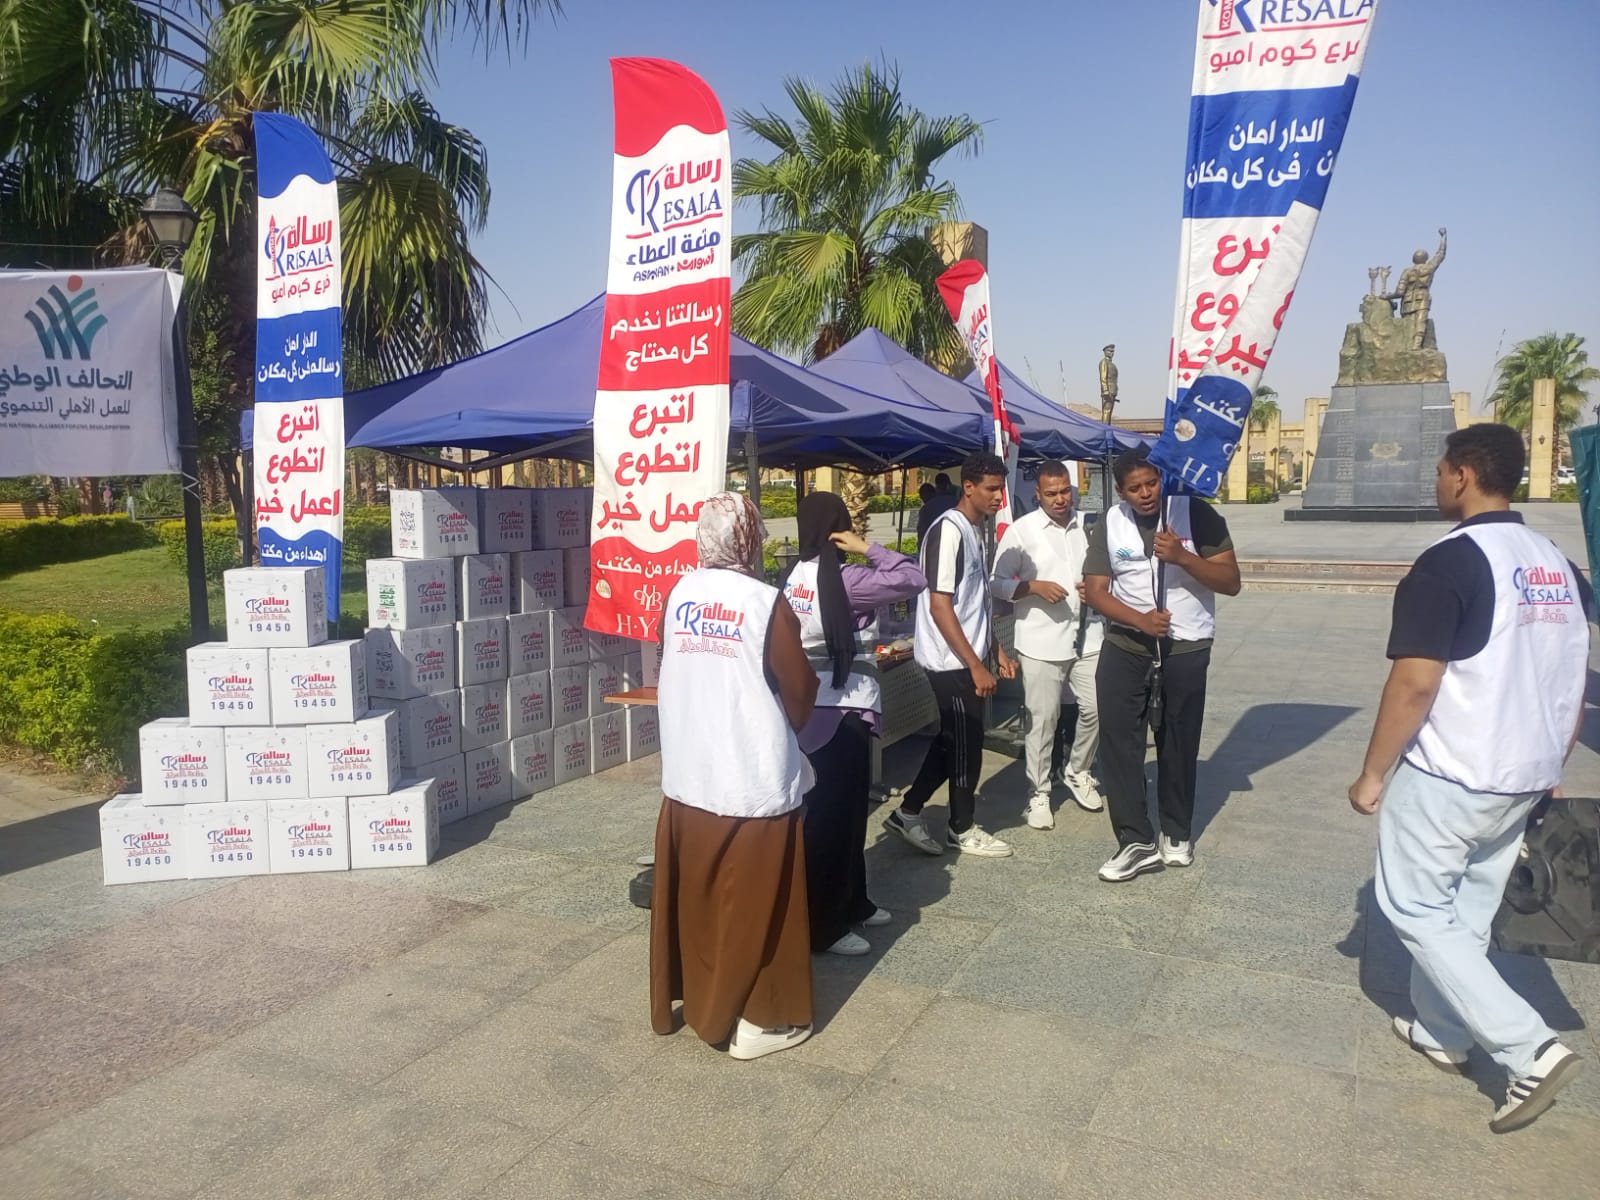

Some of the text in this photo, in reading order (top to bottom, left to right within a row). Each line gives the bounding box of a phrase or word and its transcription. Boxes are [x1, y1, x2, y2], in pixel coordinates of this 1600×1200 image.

[1210, 41, 1254, 73] امبو
[1258, 38, 1317, 67] كوم
[1228, 117, 1325, 152] الدار امان
[663, 158, 722, 190] رسالة
[1186, 159, 1229, 189] مكان
[1231, 156, 1265, 189] كل
[286, 215, 332, 249] رسالة
[626, 235, 677, 265] العطاء
[609, 301, 723, 340] رسالتنا نخدم
[625, 332, 709, 372] كل محتاج
[66, 367, 133, 391] التحالف
[258, 361, 287, 382] مكان
[59, 396, 95, 421] الأهلي
[99, 399, 131, 417] للعمل
[629, 391, 694, 439] اتبرع
[277, 404, 319, 443] اتبرع
[266, 446, 325, 485] اتطوع
[614, 440, 701, 487] اتطوع
[290, 488, 340, 523] اعمل
[597, 491, 705, 533] عمل خير
[596, 556, 642, 574] مكتب
[644, 560, 662, 579] من
[1529, 566, 1569, 588] رسالة
[676, 601, 743, 639] RESALA
[702, 602, 745, 627] رسالة
[248, 623, 291, 632] 19450
[211, 701, 254, 710] 19450
[294, 698, 336, 708] 19450
[163, 778, 208, 789] 19450
[249, 774, 291, 785] 19450
[330, 771, 372, 782] 19450
[210, 852, 253, 862] 19450
[290, 847, 333, 858] 19450
[371, 842, 412, 852] 19450
[127, 855, 171, 867] 19450
